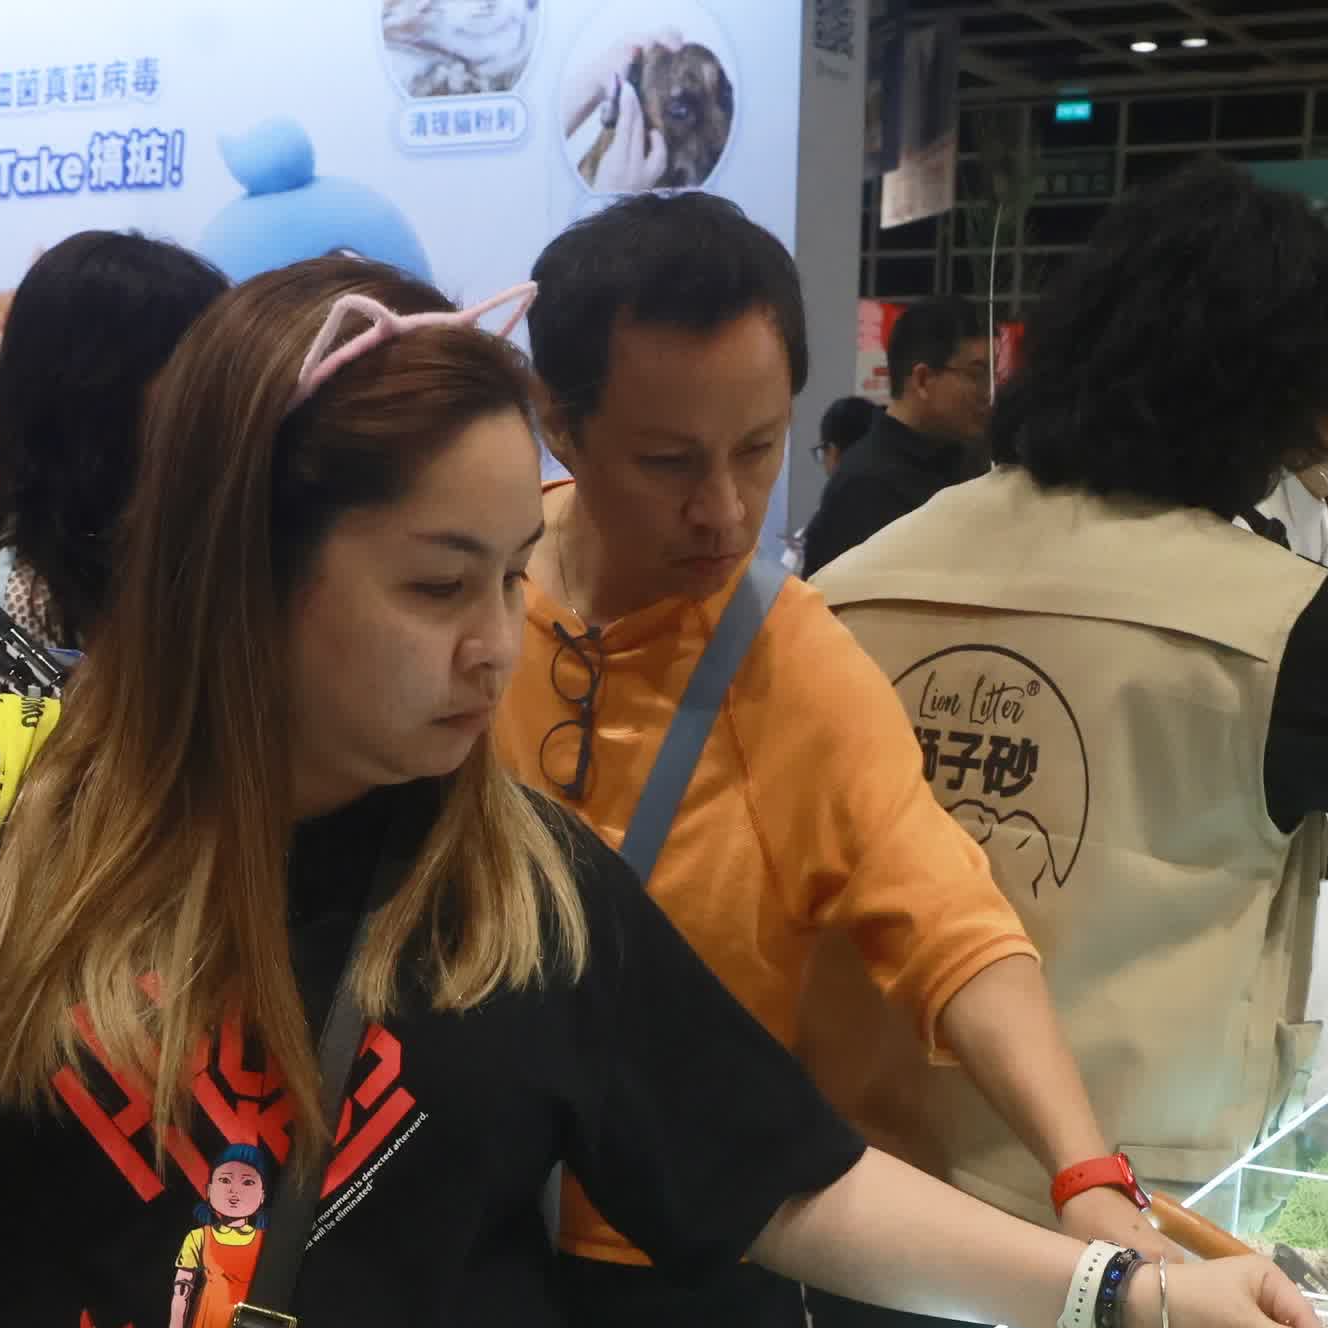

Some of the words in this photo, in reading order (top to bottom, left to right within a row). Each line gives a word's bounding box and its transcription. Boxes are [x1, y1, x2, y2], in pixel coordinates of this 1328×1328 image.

[919, 670, 961, 719] Lion
[317, 1186, 357, 1225] movement
[353, 1179, 363, 1190] is
[361, 1147, 394, 1182] detected
[392, 1111, 429, 1151] afterward,
[312, 1226, 327, 1243] will
[324, 1219, 337, 1232] be
